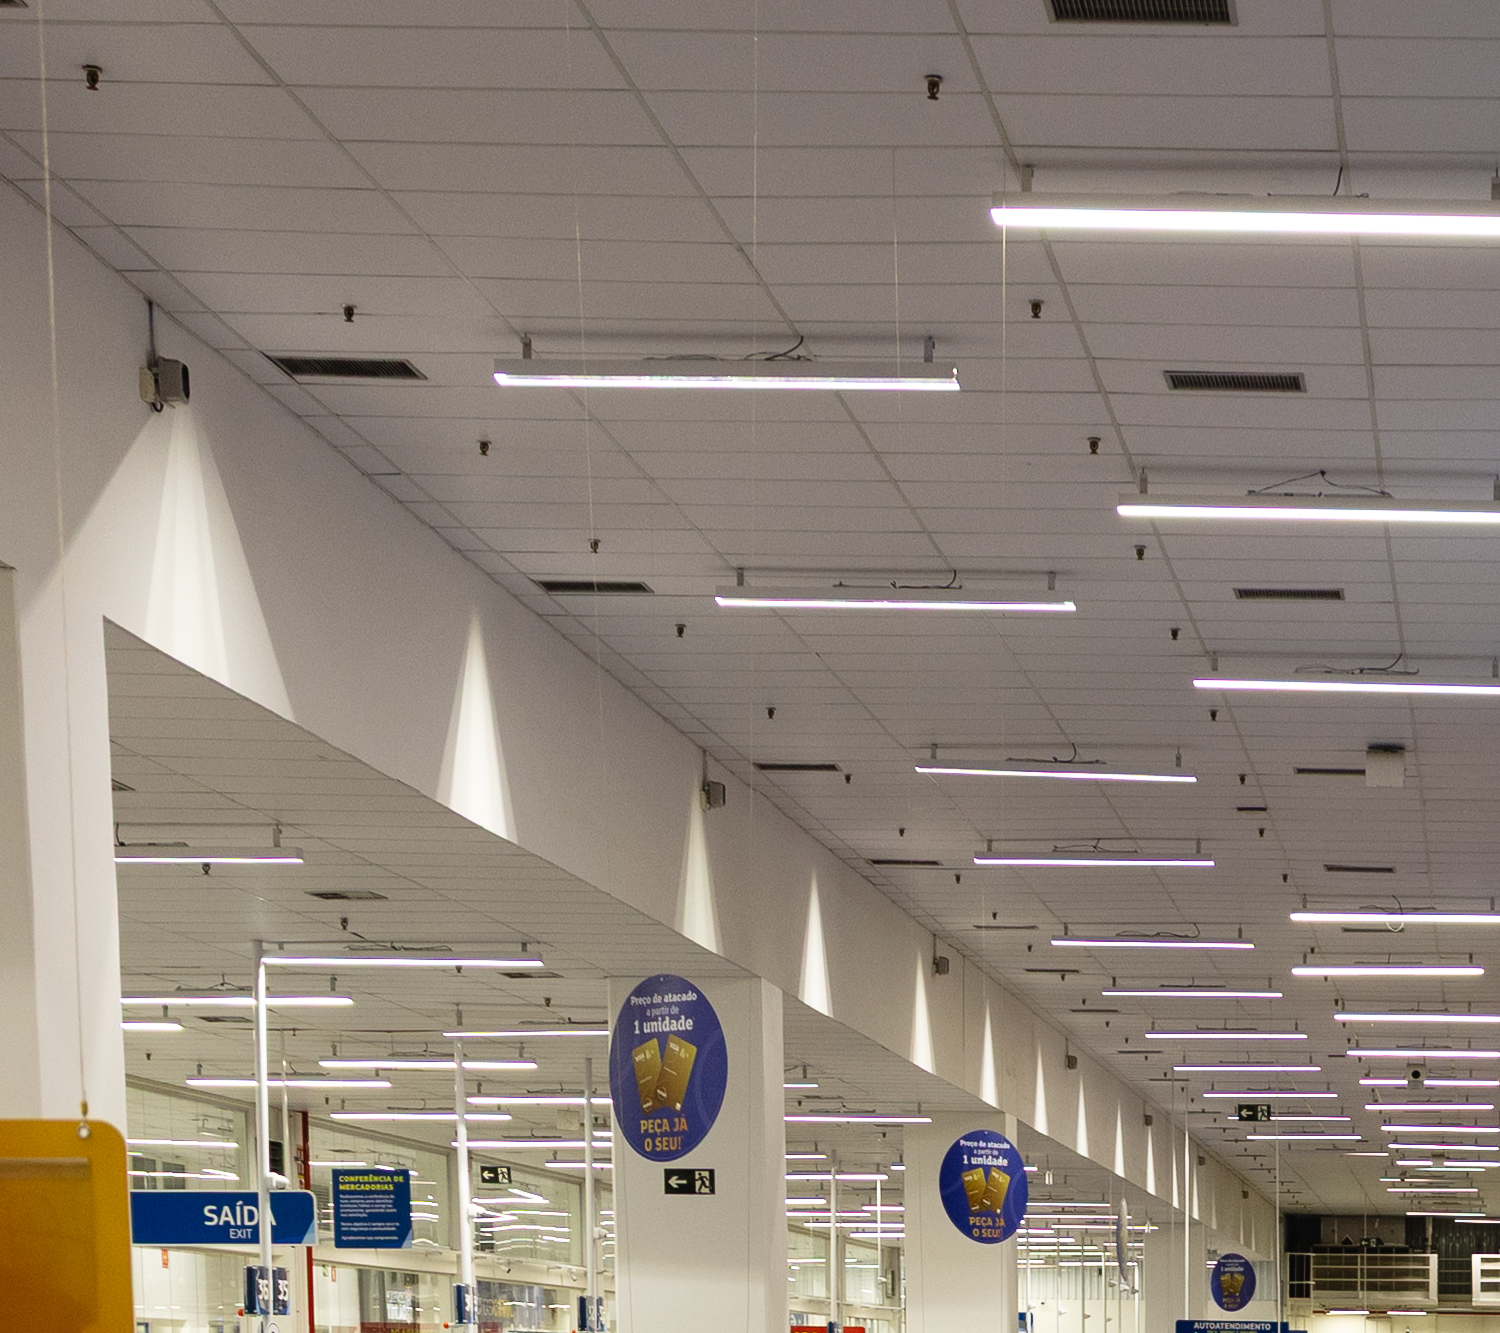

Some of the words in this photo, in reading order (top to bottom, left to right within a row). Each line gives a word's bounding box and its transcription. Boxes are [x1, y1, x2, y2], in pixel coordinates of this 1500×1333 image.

[630, 994, 651, 1007] Preço
[652, 993, 663, 1004] de
[664, 990, 698, 1003] atacado
[651, 1006, 670, 1018] partir
[634, 1021, 640, 1034] 1
[643, 1015, 694, 1033] unidade
[640, 1120, 670, 1137] PEÇA
[673, 1114, 689, 1132] JÁ
[645, 1138, 652, 1151] O
[655, 1137, 682, 1151] SEU!
[339, 1174, 392, 1183] CONFERÊNCIA
[394, 1175, 404, 1183] DE
[339, 1183, 394, 1191] MERCADORIAS
[229, 1228, 252, 1239] EXIT
[258, 1279, 269, 1300] 36
[277, 1279, 289, 1300] 35
[1193, 1322, 1271, 1330] AUTOATENDIMENTO
